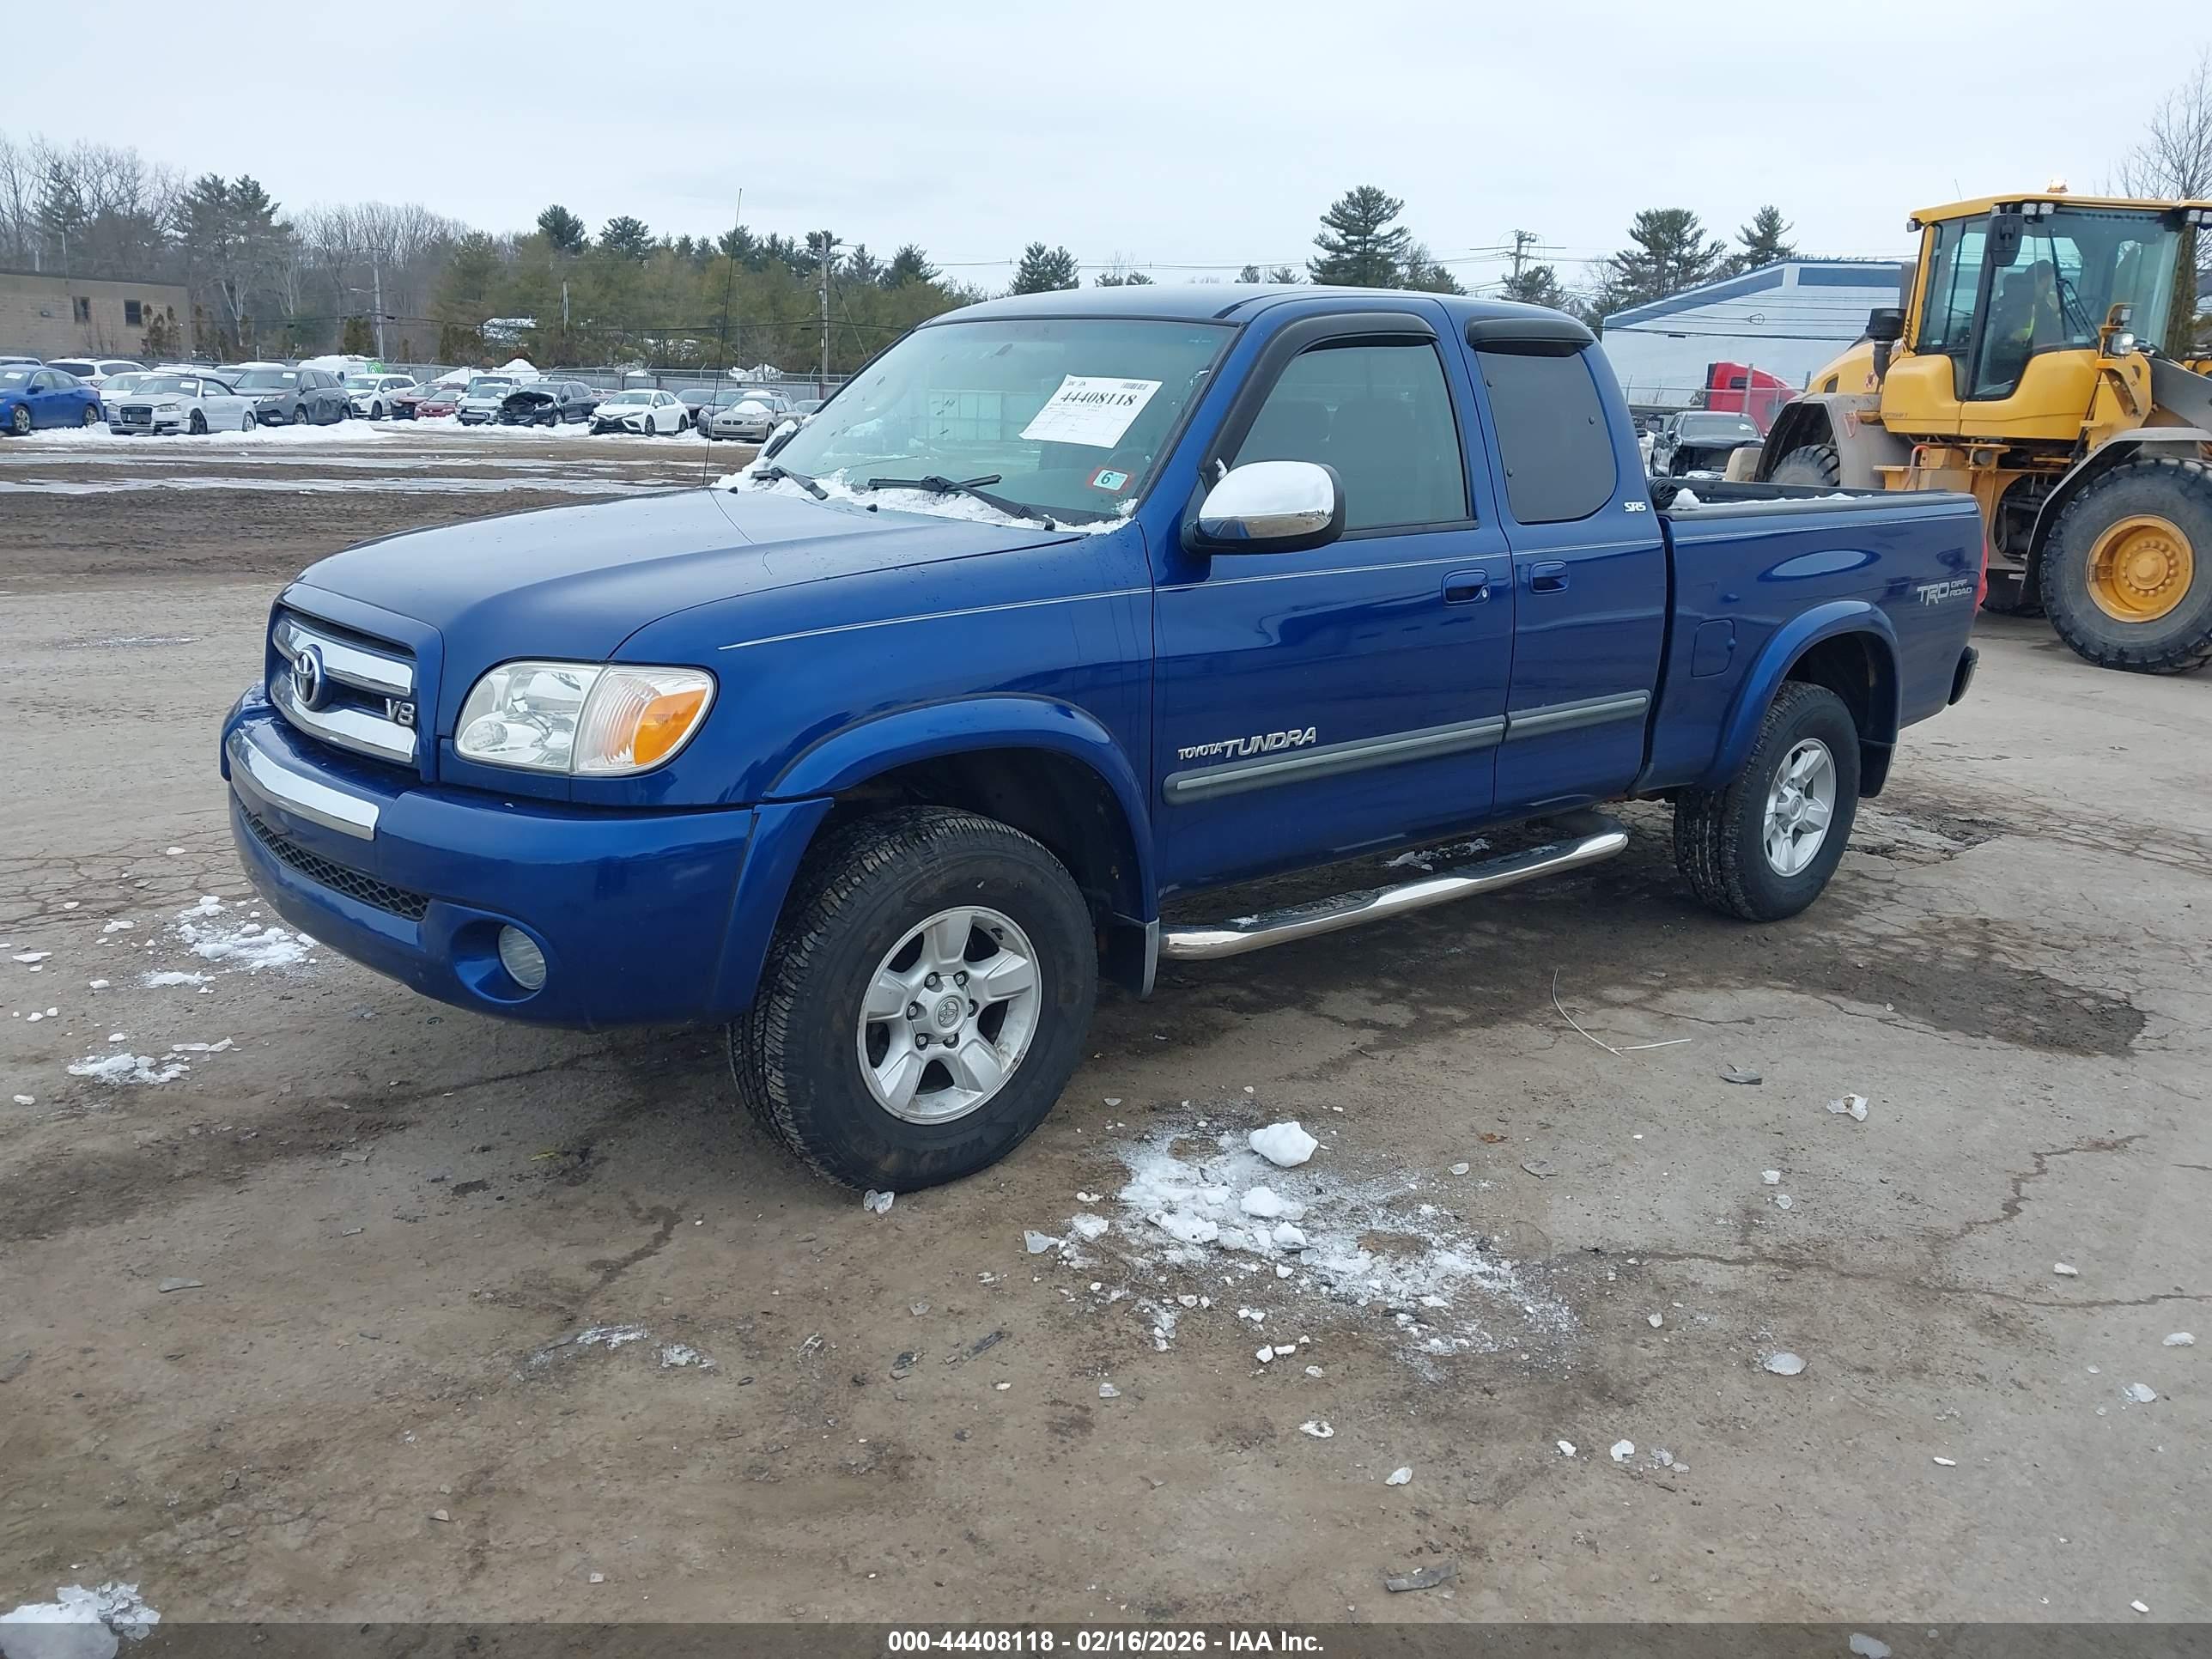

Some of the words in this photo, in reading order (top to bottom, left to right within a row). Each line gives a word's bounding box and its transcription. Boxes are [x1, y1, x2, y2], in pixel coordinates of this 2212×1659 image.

[1060, 391, 1138, 407] 44408118
[1101, 472, 1114, 484] 6
[1624, 501, 1646, 513] SR5
[1951, 579, 1968, 588] OFF
[1917, 582, 1950, 606] TRD
[1949, 586, 1972, 597] ROAD
[386, 698, 415, 726] V8
[1178, 742, 1223, 761] TOYOTA
[1220, 726, 1316, 758] TUNDRA
